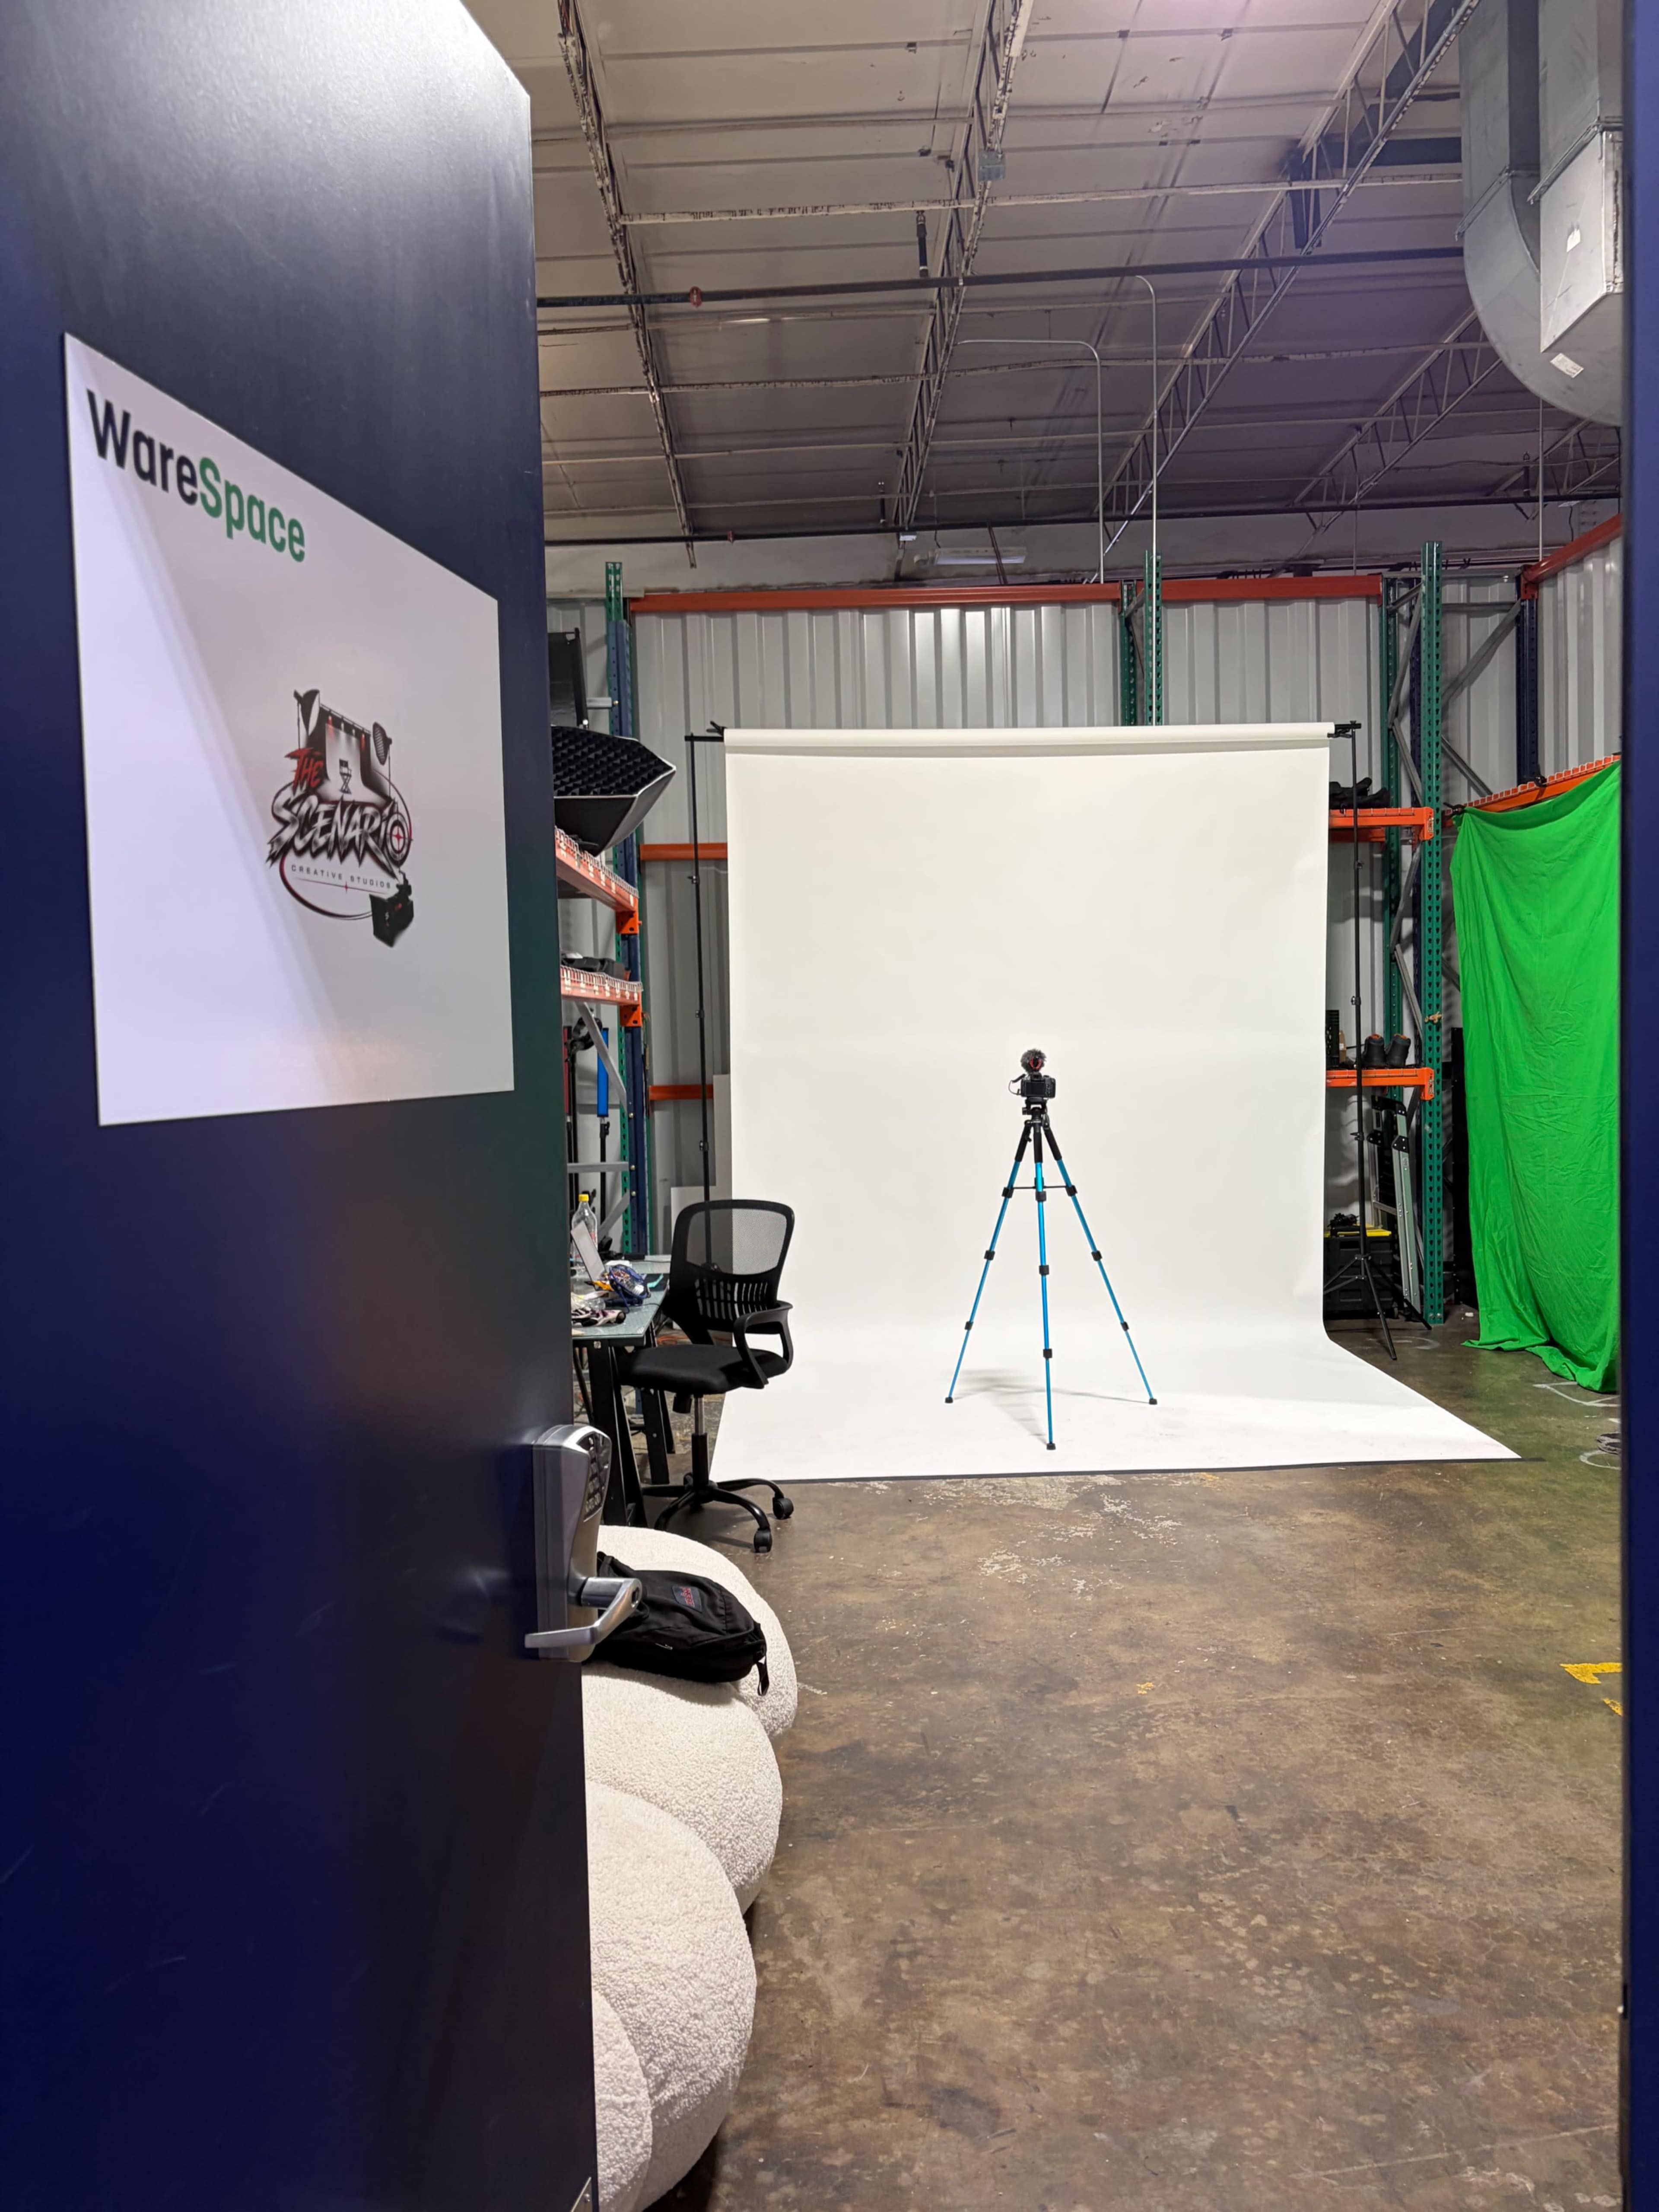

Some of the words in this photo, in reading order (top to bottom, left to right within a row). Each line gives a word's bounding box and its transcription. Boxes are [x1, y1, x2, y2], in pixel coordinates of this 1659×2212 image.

[87, 388, 305, 562] WareSpace
[284, 748, 324, 793] THE
[265, 795, 412, 880] SCENARIO
[292, 865, 343, 880] CREATIVE
[350, 875, 390, 888] STUDIOS
